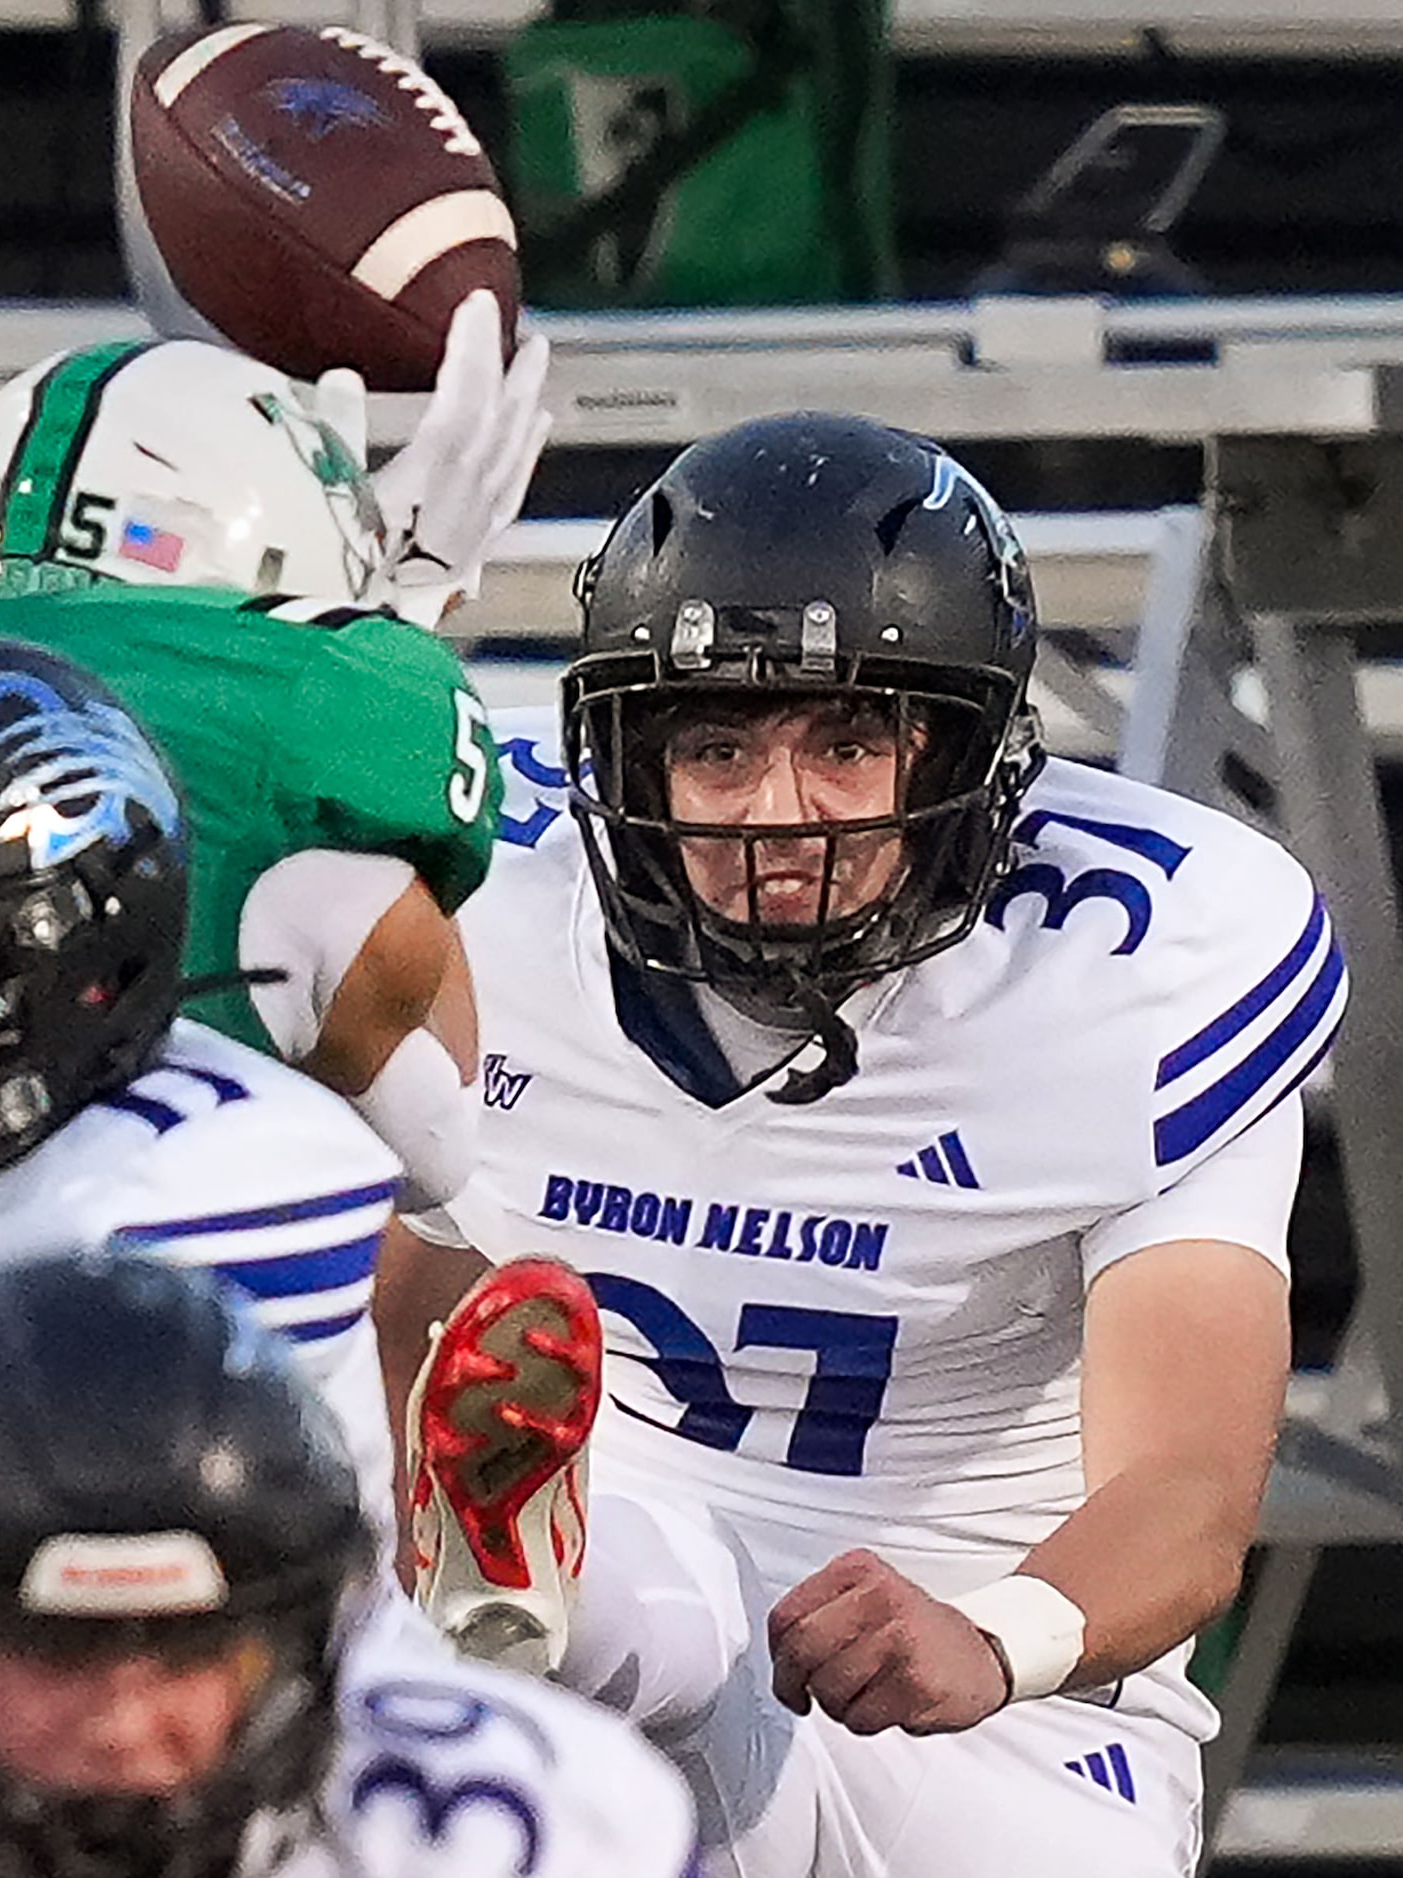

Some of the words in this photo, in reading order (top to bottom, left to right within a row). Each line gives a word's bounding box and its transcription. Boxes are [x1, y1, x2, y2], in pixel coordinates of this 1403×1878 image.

[64, 490, 117, 560] 5
[448, 686, 489, 824] 5
[982, 808, 1194, 956] 37
[537, 1174, 693, 1247] BYRON
[695, 1202, 890, 1272] NELSON
[349, 1681, 557, 1877] 39
